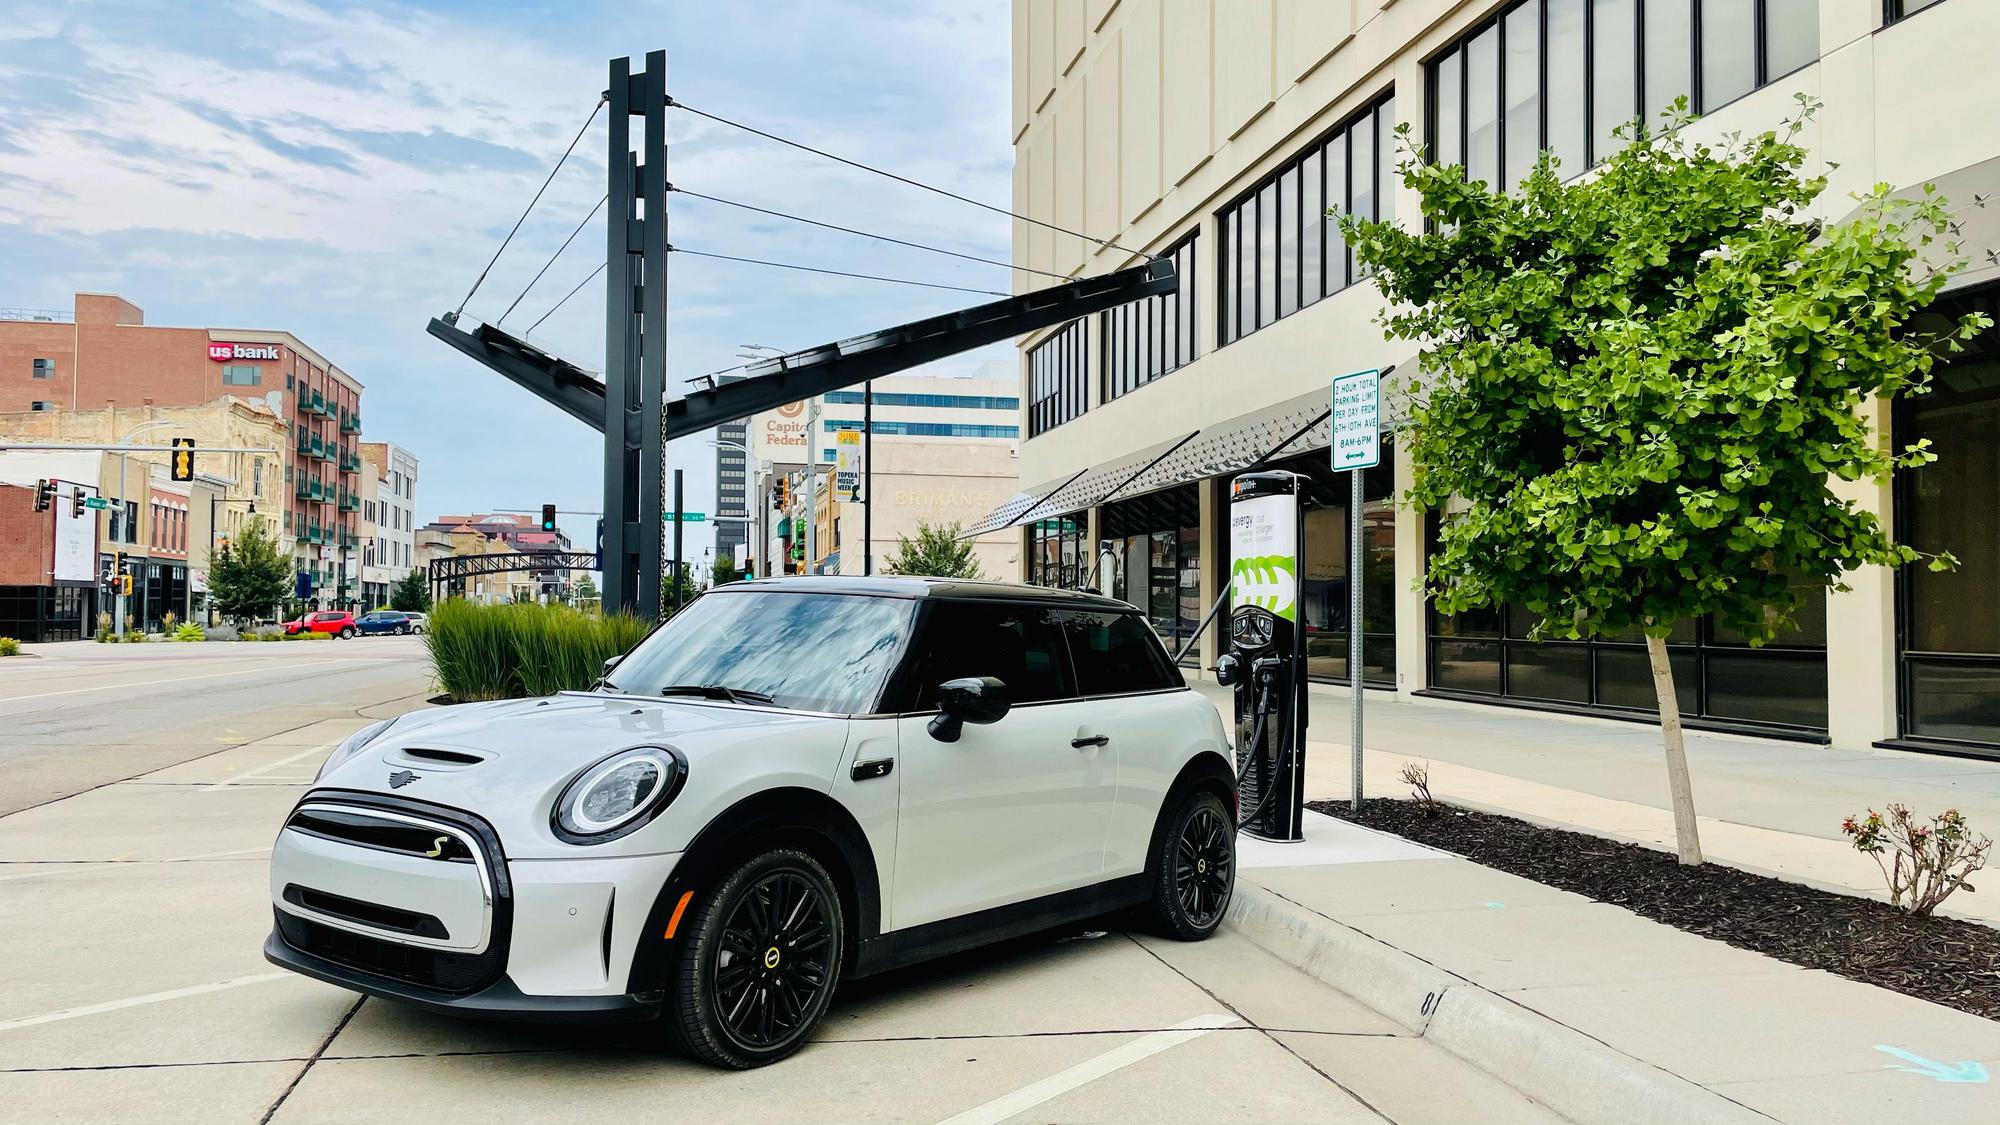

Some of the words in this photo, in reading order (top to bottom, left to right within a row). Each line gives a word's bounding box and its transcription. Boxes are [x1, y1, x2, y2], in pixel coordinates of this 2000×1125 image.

[210, 346, 232, 358] us
[234, 345, 279, 359] bank
[1336, 387, 1339, 395] 2
[1342, 384, 1356, 392] HOUR
[1360, 379, 1376, 389] TOTAL
[1336, 394, 1359, 406] PARKING
[1362, 391, 1376, 401] LIMIT
[1336, 411, 1345, 419] PER
[1348, 408, 1358, 417] DAY
[1362, 405, 1376, 414] FROM
[767, 420, 805, 433] Capit
[1335, 422, 1361, 433] 6TH-10TH
[1365, 418, 1376, 427] AVE
[766, 434, 808, 446] Federa
[838, 432, 859, 440] JUNE
[1341, 436, 1372, 448] 8AM-6PM
[876, 765, 884, 774] S
[426, 836, 448, 858] S
